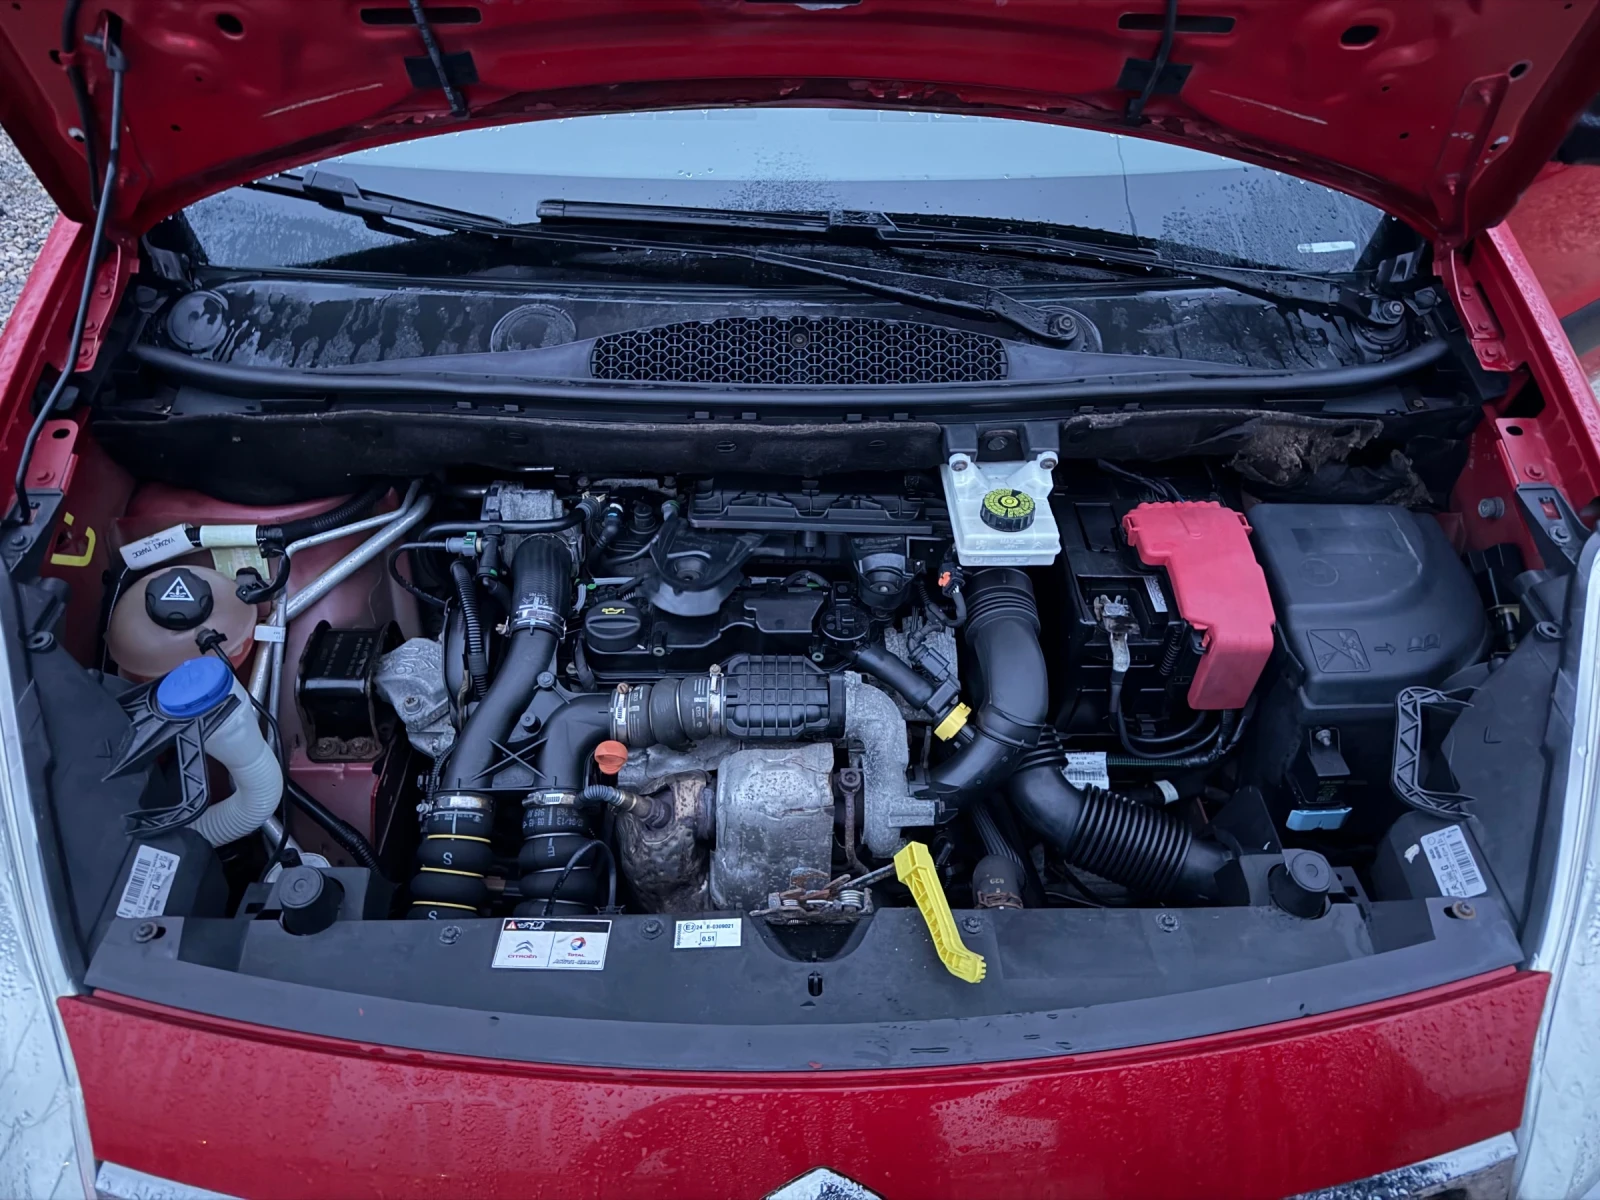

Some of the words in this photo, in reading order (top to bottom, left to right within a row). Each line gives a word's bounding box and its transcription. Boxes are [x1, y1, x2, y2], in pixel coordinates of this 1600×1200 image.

[153, 537, 176, 550] YAZAKI
[131, 546, 153, 559] MAROC
[443, 852, 453, 865] S
